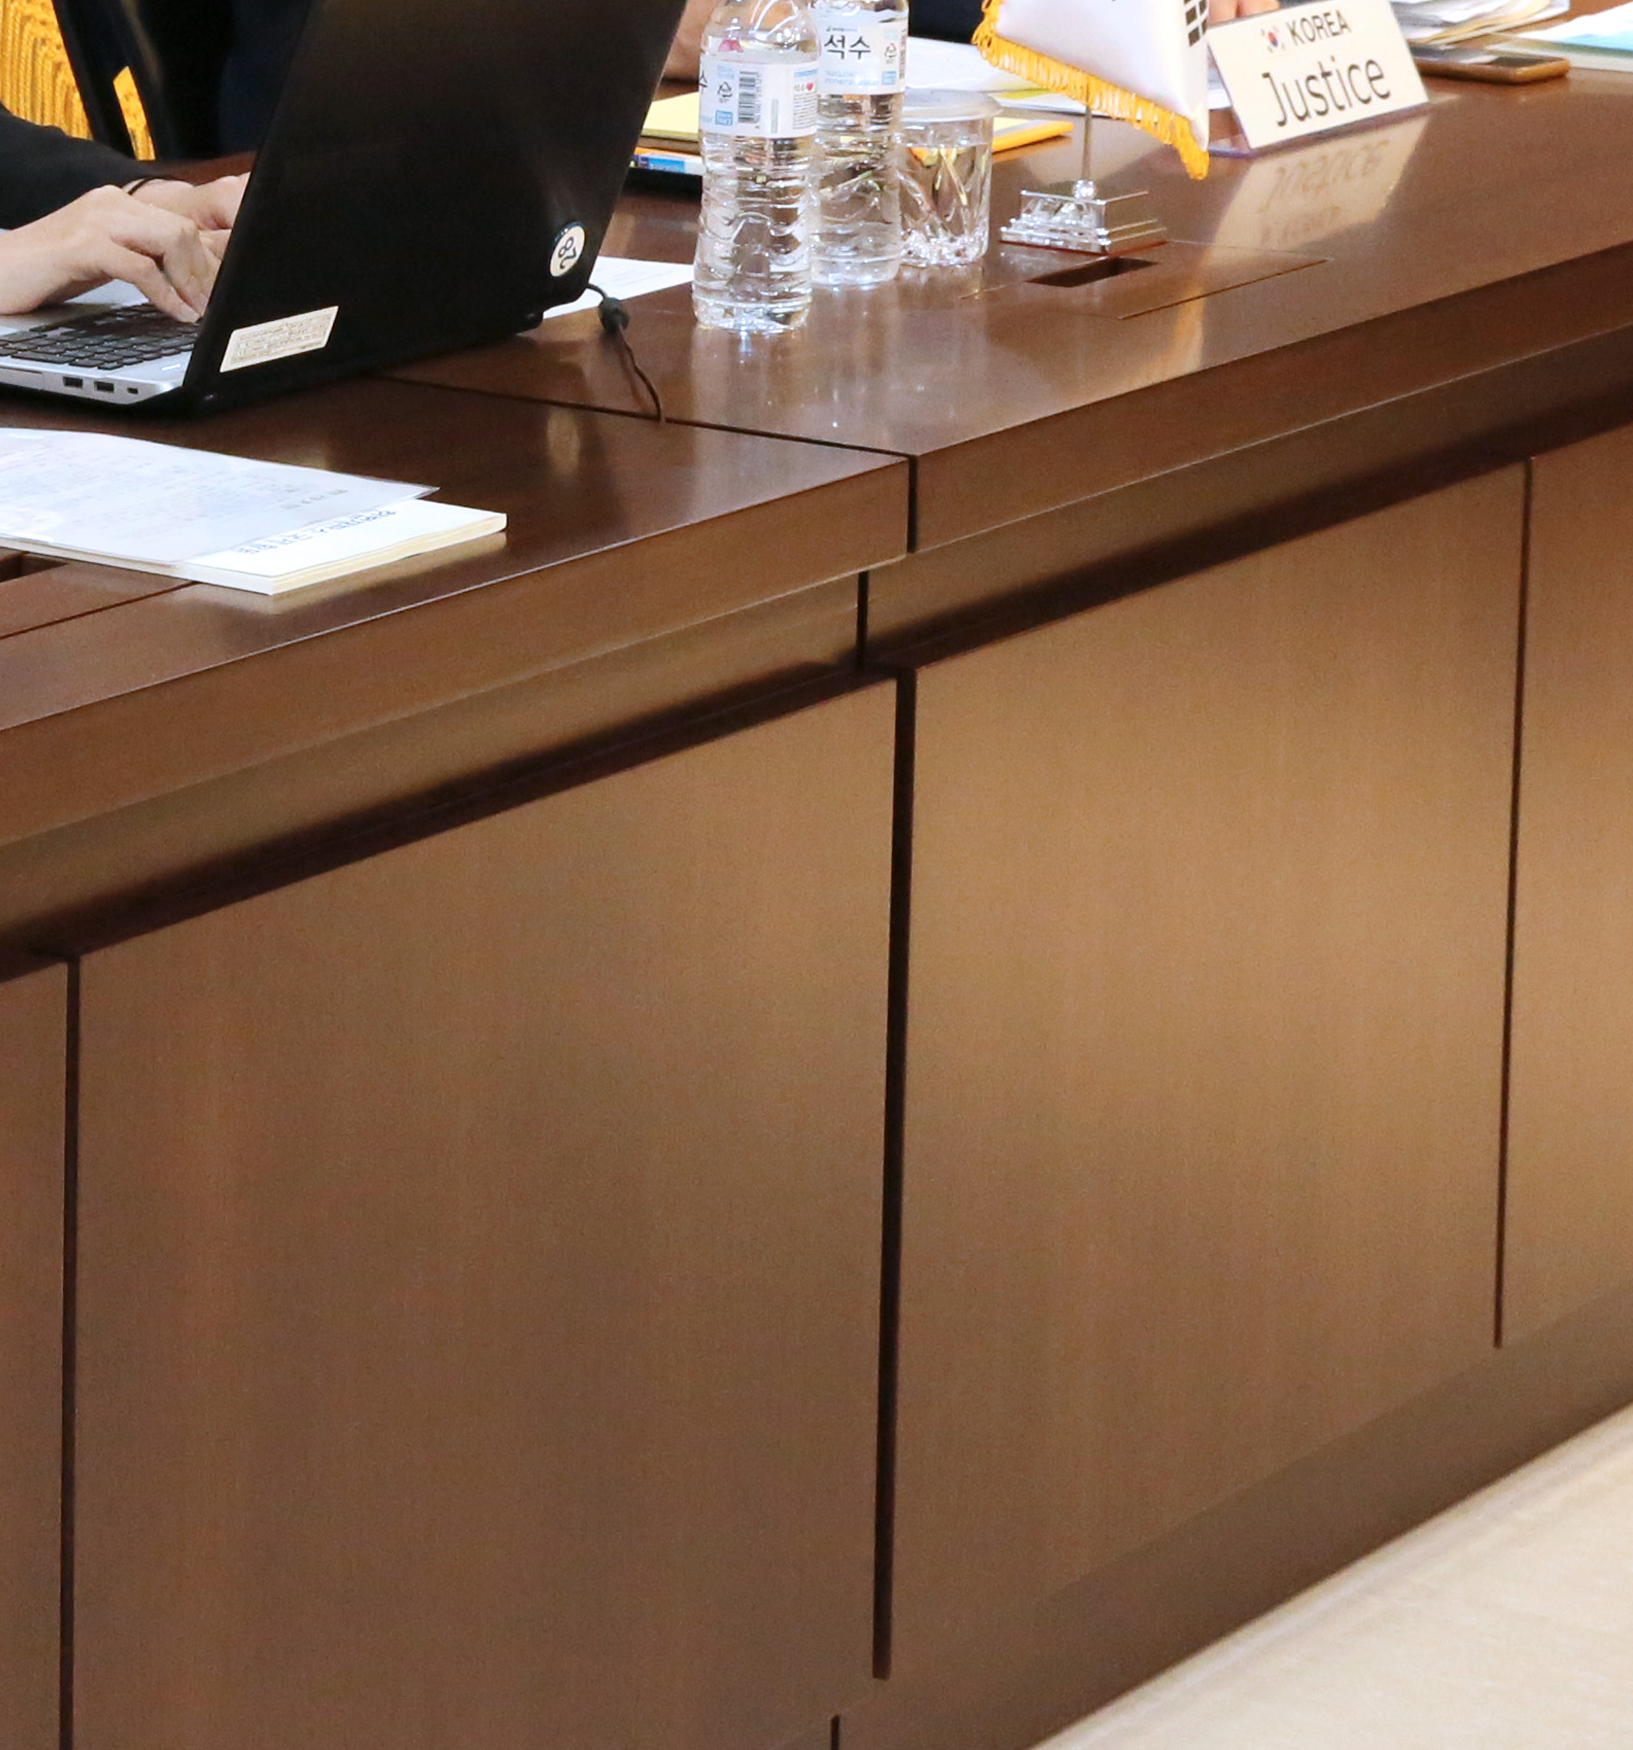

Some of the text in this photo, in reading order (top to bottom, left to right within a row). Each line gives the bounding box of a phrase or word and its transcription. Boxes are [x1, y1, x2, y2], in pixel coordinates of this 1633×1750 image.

[1285, 8, 1353, 44] KOREA
[823, 35, 871, 60] 석수
[1261, 55, 1392, 127] Justice
[558, 236, 577, 270] 28
